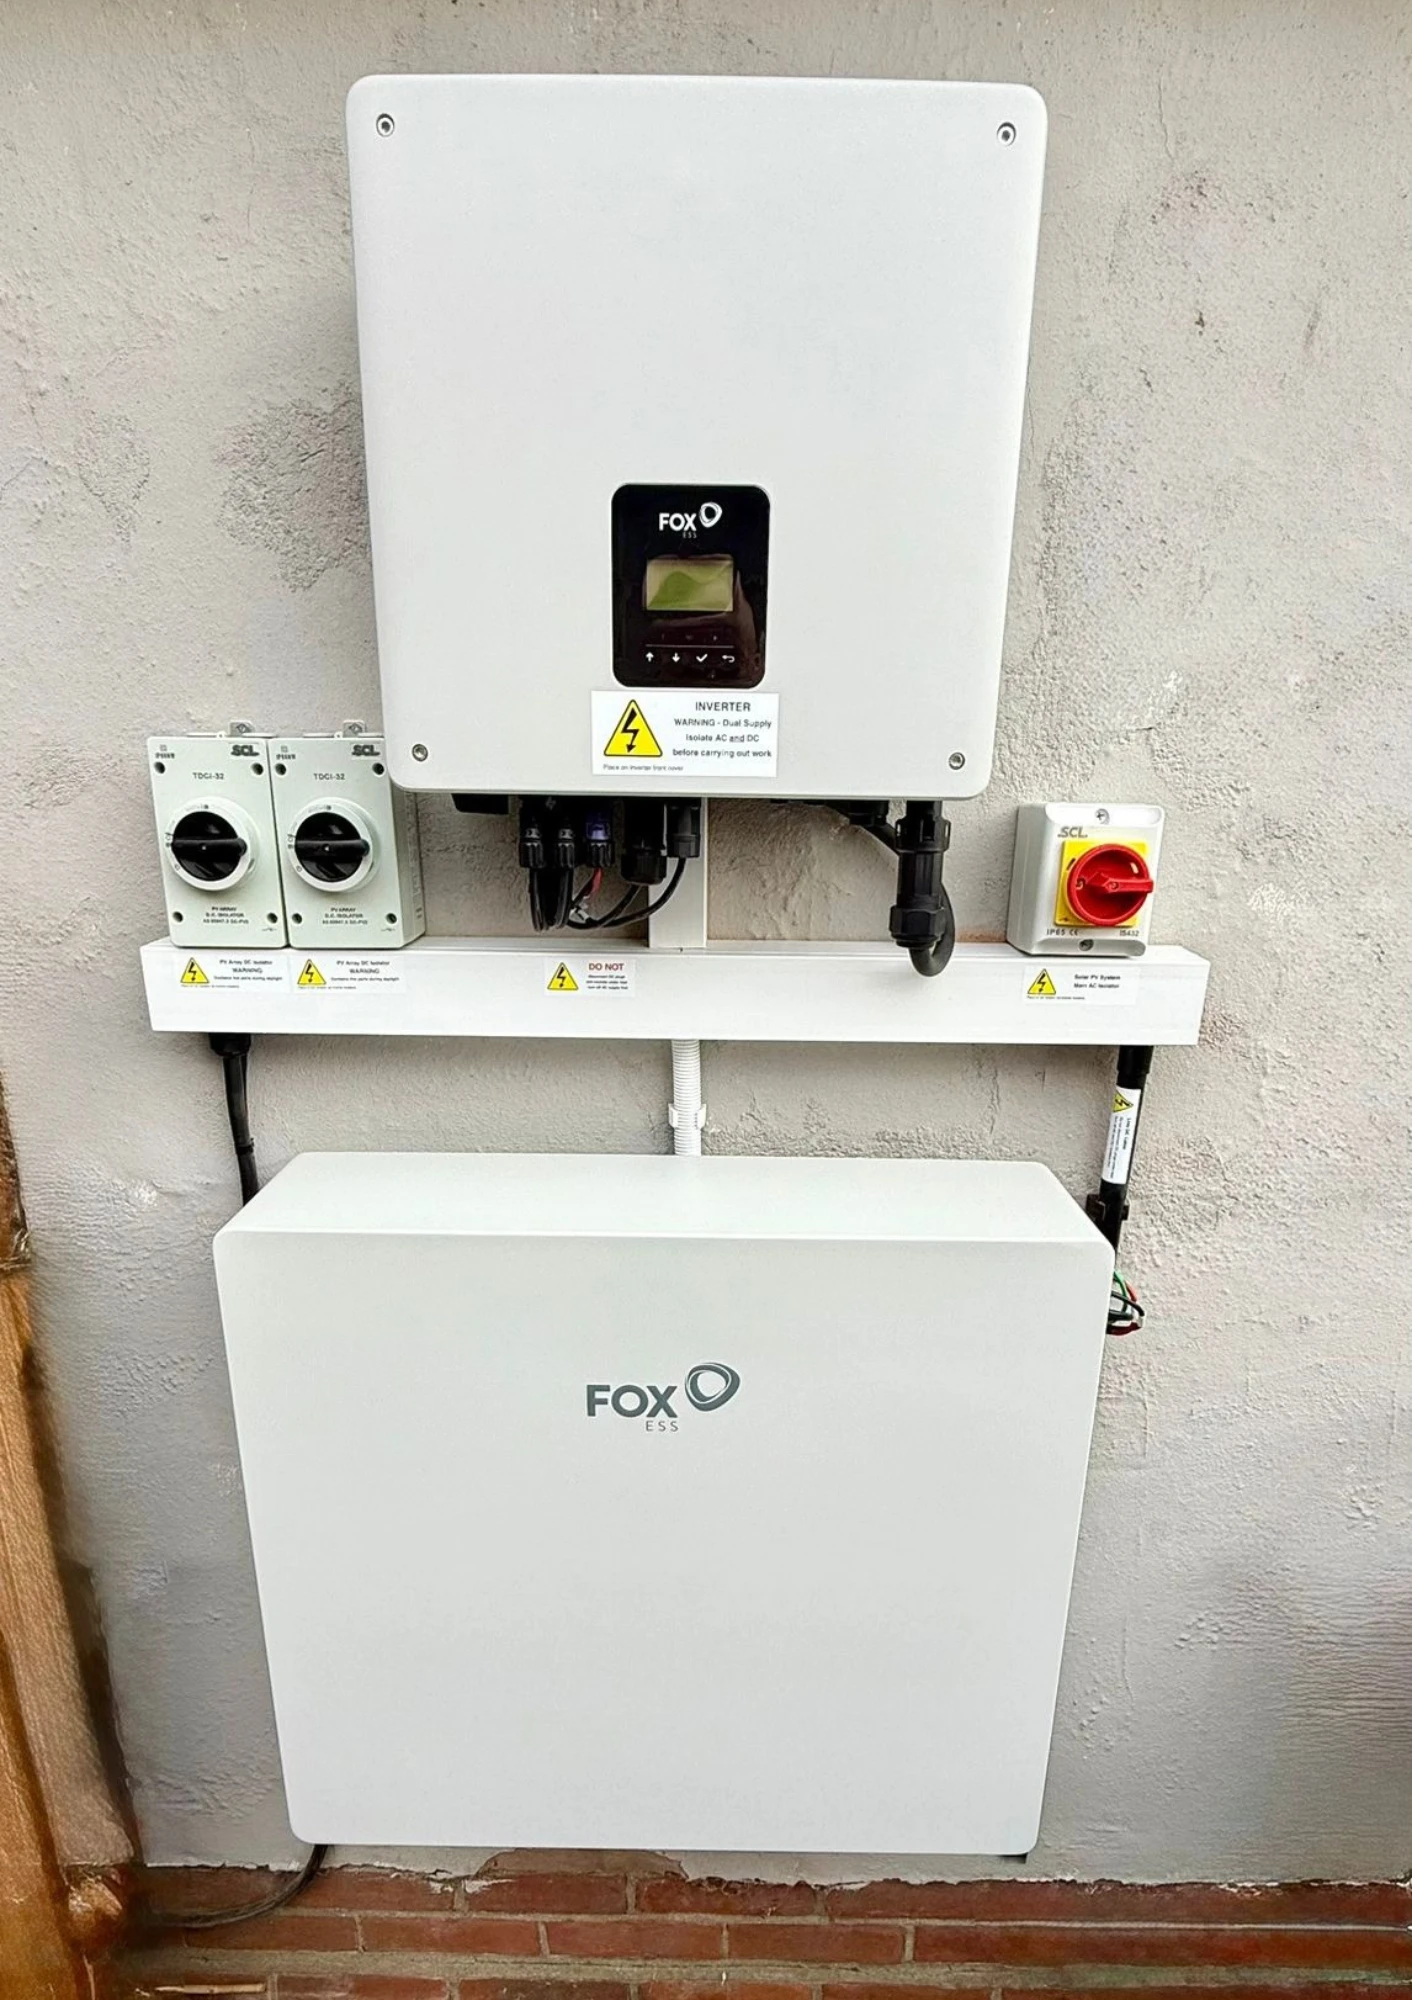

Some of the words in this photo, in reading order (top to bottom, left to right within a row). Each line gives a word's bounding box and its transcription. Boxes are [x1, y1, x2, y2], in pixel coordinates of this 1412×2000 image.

[658, 512, 697, 532] FOX
[682, 531, 698, 539] ESS
[695, 701, 751, 712] INVERTER
[673, 718, 716, 728] WARNING
[722, 719, 742, 728] Dual
[743, 719, 772, 730] Supply
[685, 733, 713, 742] Isolate
[715, 734, 728, 743] AC
[729, 734, 745, 743] and
[746, 734, 760, 743] DC
[230, 744, 260, 756] SCL
[351, 744, 380, 756] SCL
[672, 748, 699, 758] before
[700, 749, 735, 759] carrying
[736, 749, 750, 759] out
[751, 749, 772, 758] work
[1056, 826, 1088, 838] SCL
[1046, 928, 1066, 936] IP65
[588, 962, 603, 971] DO
[604, 962, 625, 971] NOT
[586, 1384, 678, 1418] FOX
[645, 1420, 679, 1432] ESS
